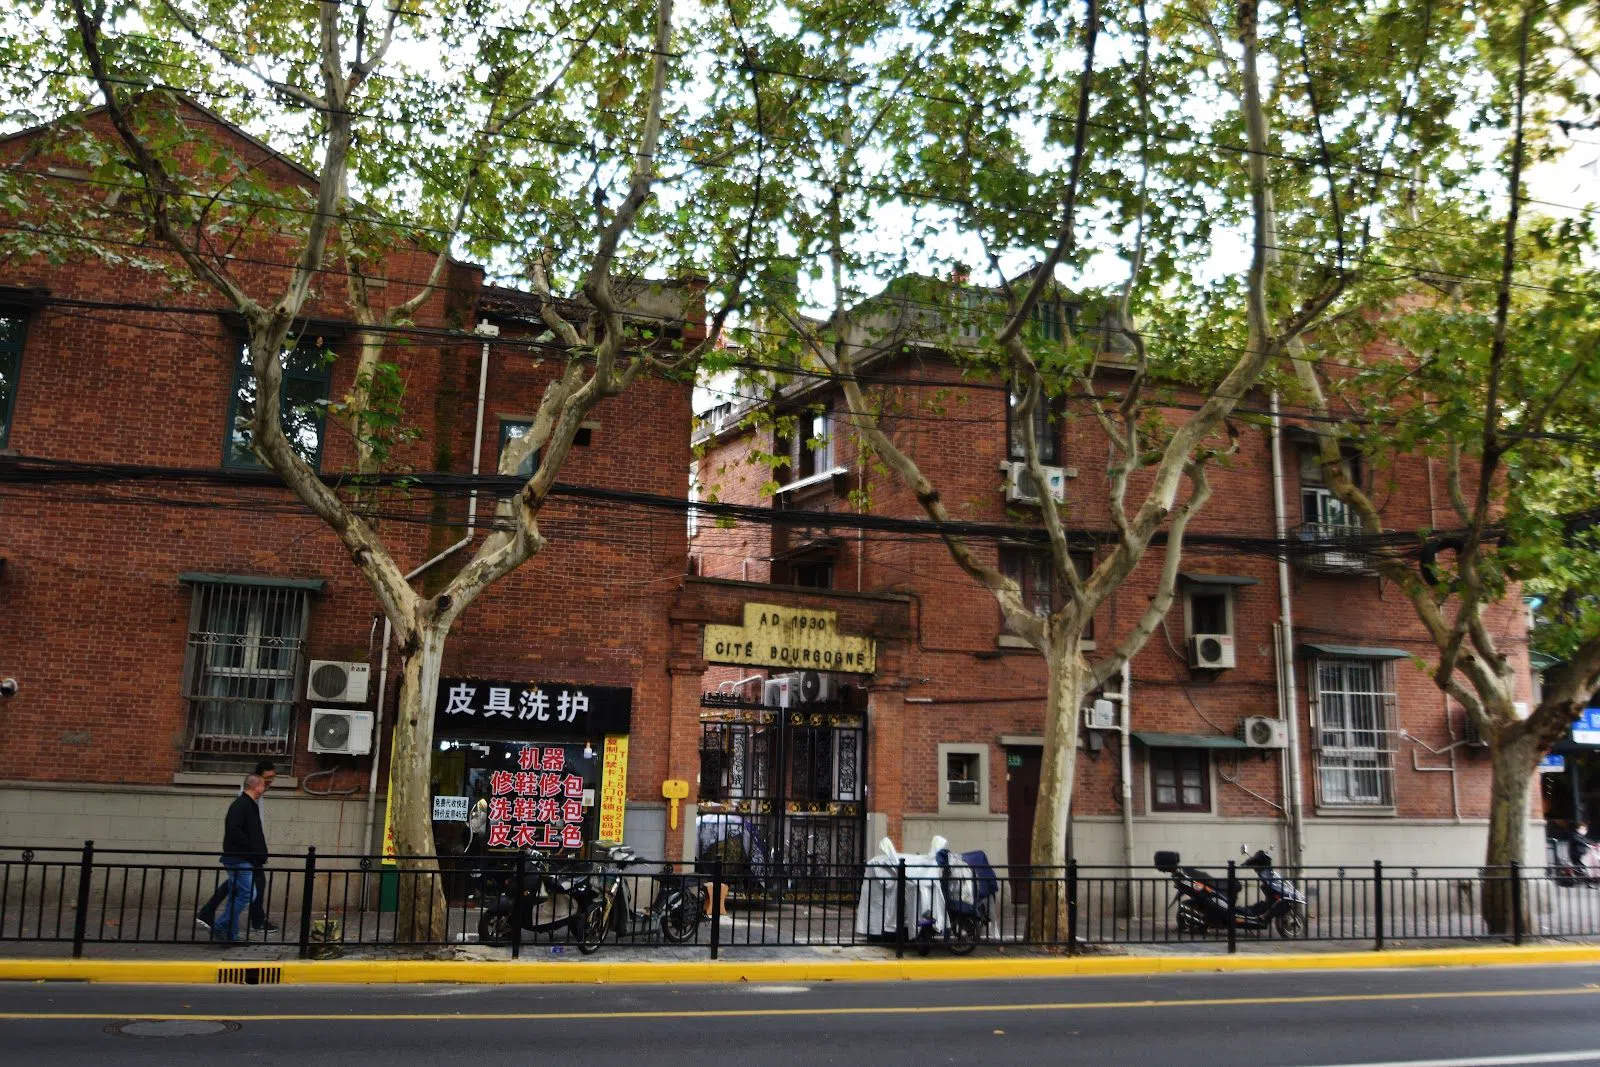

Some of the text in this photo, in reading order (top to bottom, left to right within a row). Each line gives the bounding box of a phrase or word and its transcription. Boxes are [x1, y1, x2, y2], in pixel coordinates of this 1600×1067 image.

[760, 613, 825, 630] AD 1930
[715, 641, 865, 665] CITÉ BOURGOGNE
[445, 683, 589, 722] 皮具洗护
[518, 747, 565, 772] 机器
[490, 771, 583, 798] 修鞋修包
[488, 797, 583, 823] 洗鞋洗包
[488, 823, 583, 849] 皮衣上色
